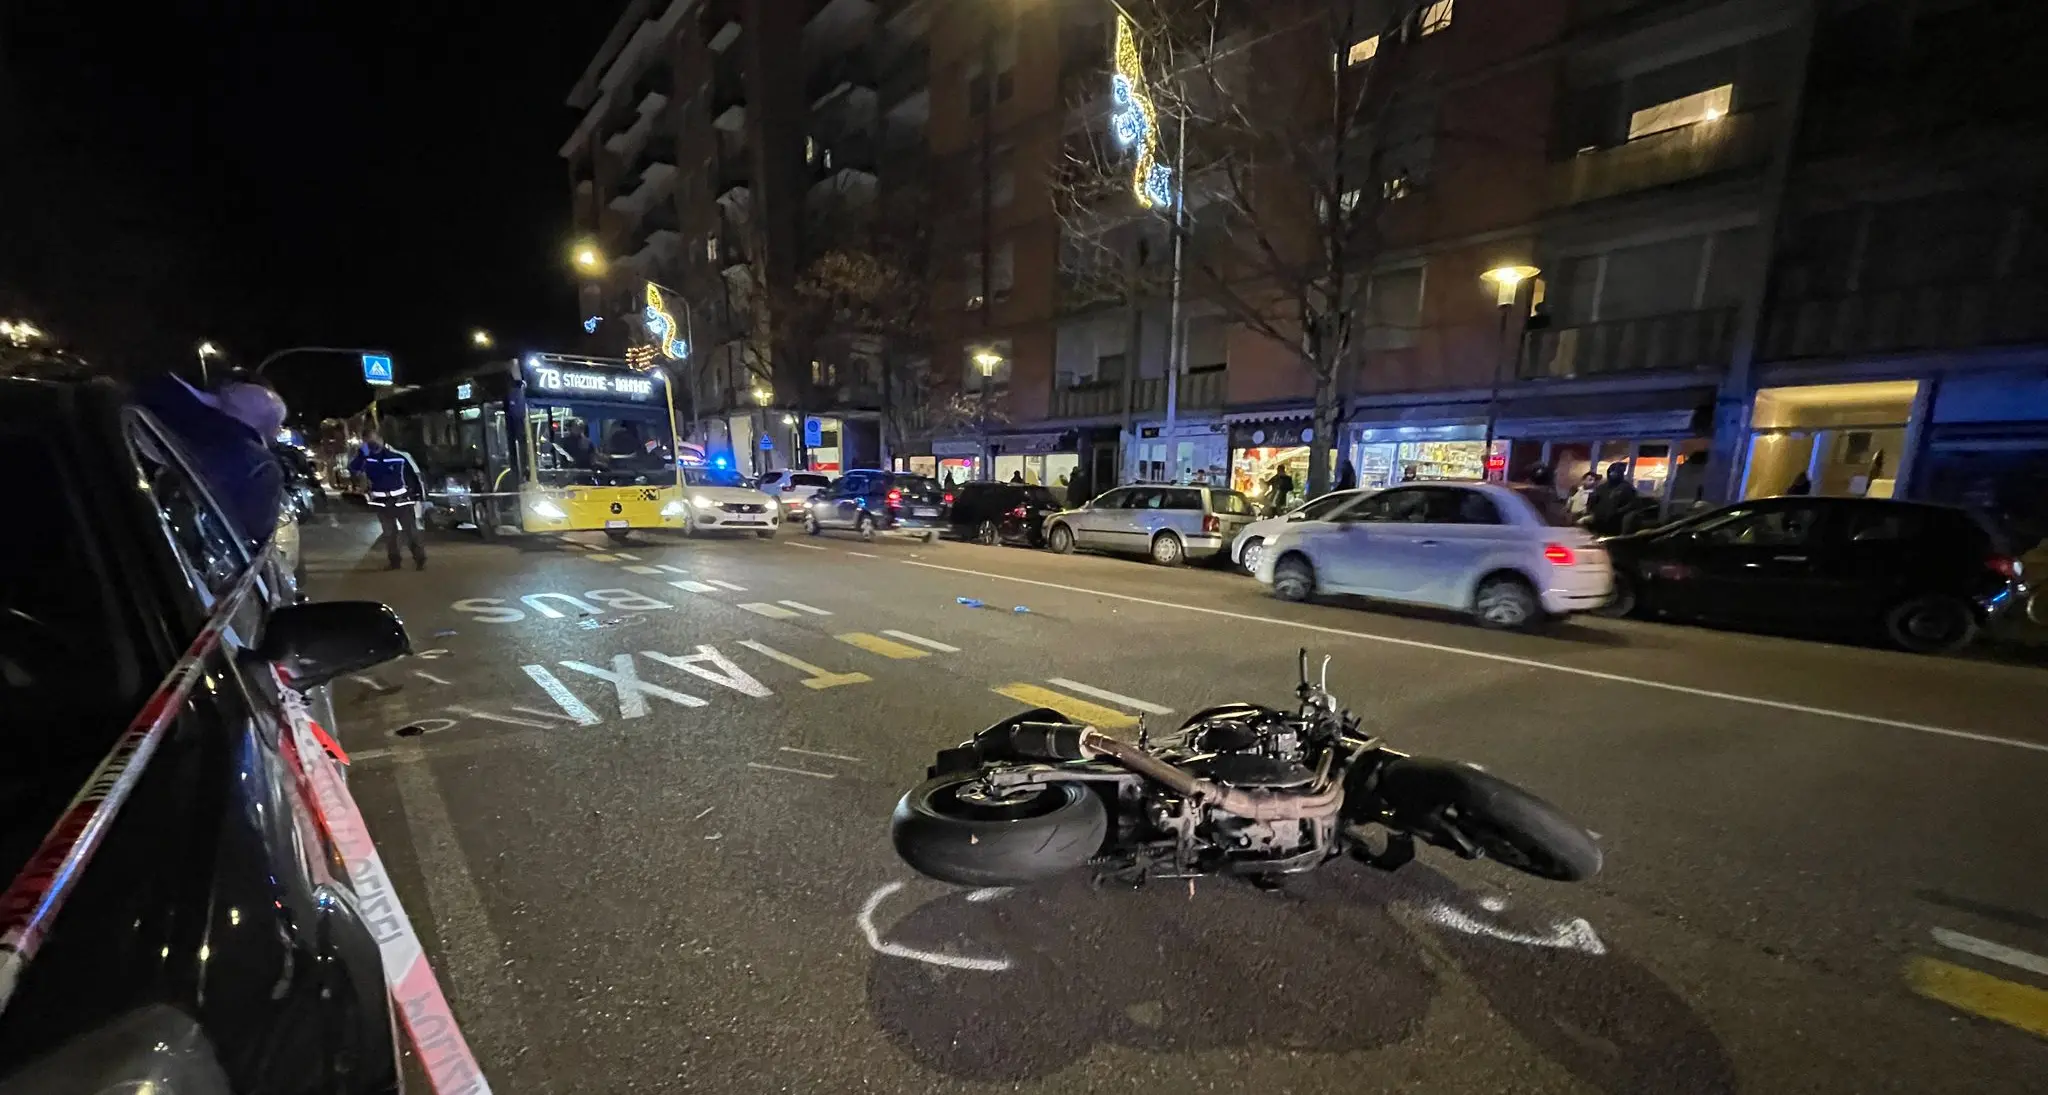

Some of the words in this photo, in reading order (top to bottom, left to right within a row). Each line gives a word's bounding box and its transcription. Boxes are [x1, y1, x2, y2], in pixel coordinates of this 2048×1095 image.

[536, 368, 560, 389] 7B
[563, 373, 608, 391] STAZIONE
[451, 588, 674, 623] BUS
[521, 638, 874, 727] TAXI
